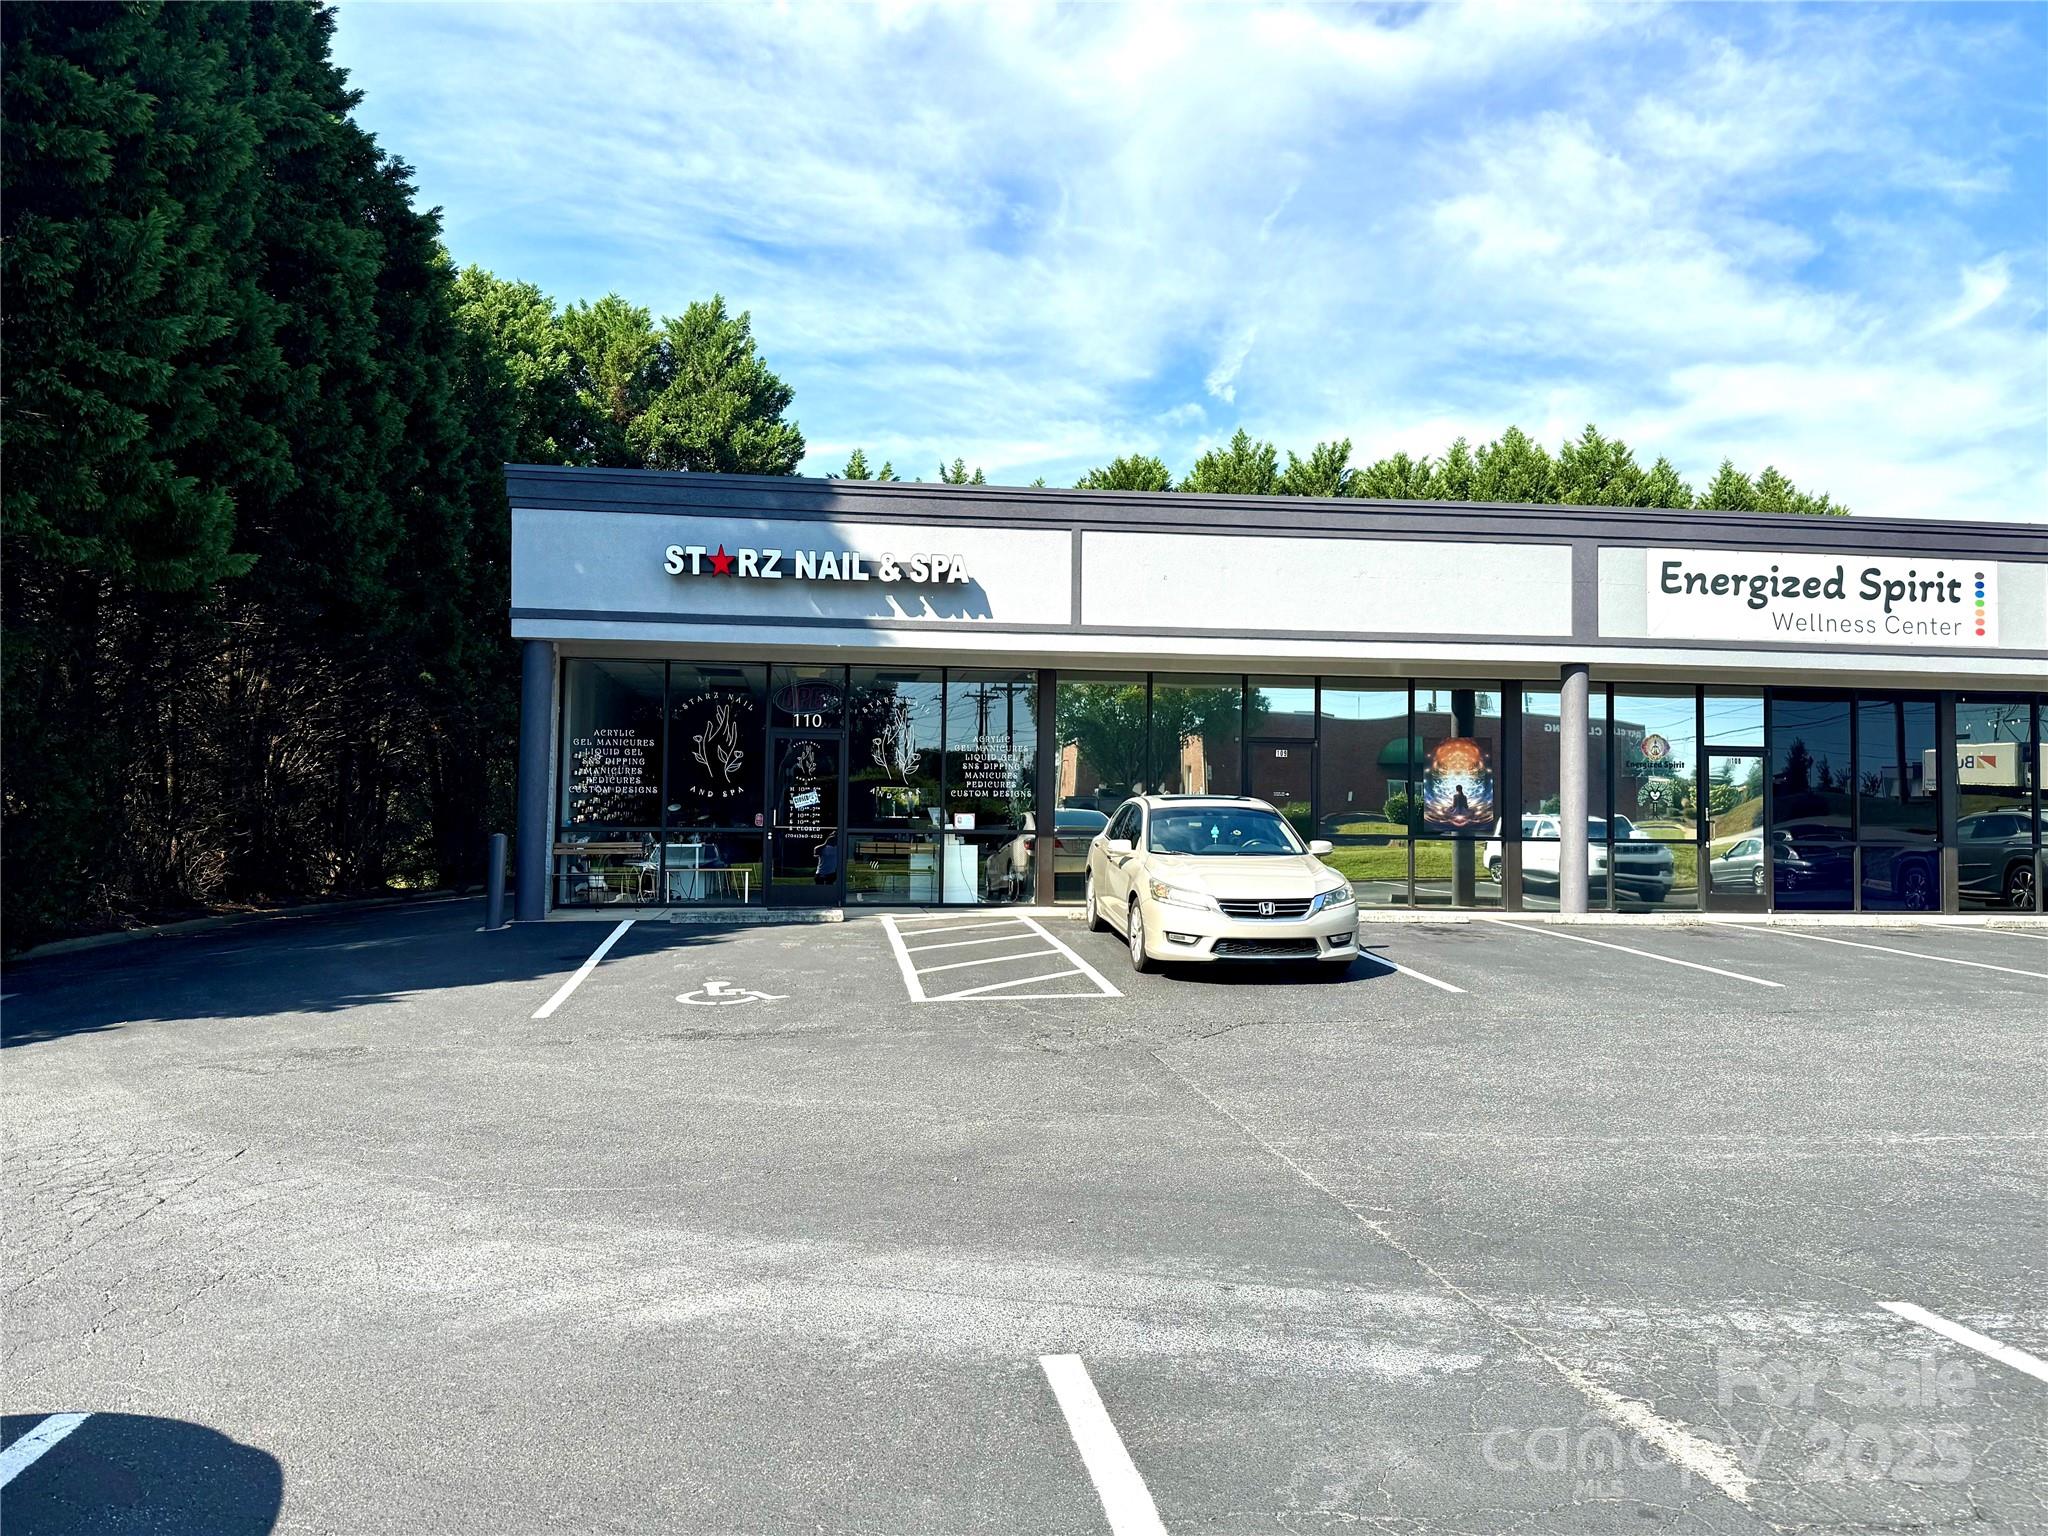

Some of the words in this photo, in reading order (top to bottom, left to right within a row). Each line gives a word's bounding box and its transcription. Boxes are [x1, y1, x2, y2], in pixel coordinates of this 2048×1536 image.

[795, 549, 869, 582] NAIL
[878, 552, 902, 583] &
[910, 553, 970, 584] SPA
[1660, 561, 1846, 610] Energized
[1859, 567, 1962, 614] Spirit
[1772, 611, 1877, 634] Wellness
[1885, 615, 1963, 636] Center
[682, 692, 719, 709] STARZ
[728, 693, 753, 711] NAIL
[794, 714, 822, 728] 110
[593, 729, 635, 737] ACRYLIC
[573, 738, 592, 746] GEL
[597, 739, 655, 747] MANICURES
[973, 735, 1011, 743] ACRYLIC
[585, 748, 620, 757] LIQUID
[624, 748, 643, 756] GEL
[954, 744, 972, 752] GEL
[975, 744, 1029, 752] MANICURES
[605, 758, 645, 766] DIPPING
[965, 753, 997, 762] LIQUID
[962, 762, 980, 770] SNS
[984, 762, 1021, 770] DIPPING
[1626, 760, 1663, 769] Energized
[1664, 760, 1685, 769] Spirit
[584, 767, 643, 775] MANICURES
[586, 776, 641, 784] PEDICURES
[964, 772, 1018, 780] MANICURES
[966, 780, 1017, 788] PEDICURES
[569, 785, 611, 794] CUSTOM
[615, 786, 658, 794] DESIGNS
[690, 786, 714, 797] AND
[722, 786, 744, 797] SPA
[869, 787, 892, 799] AND
[993, 790, 1033, 798] DESIGNS
